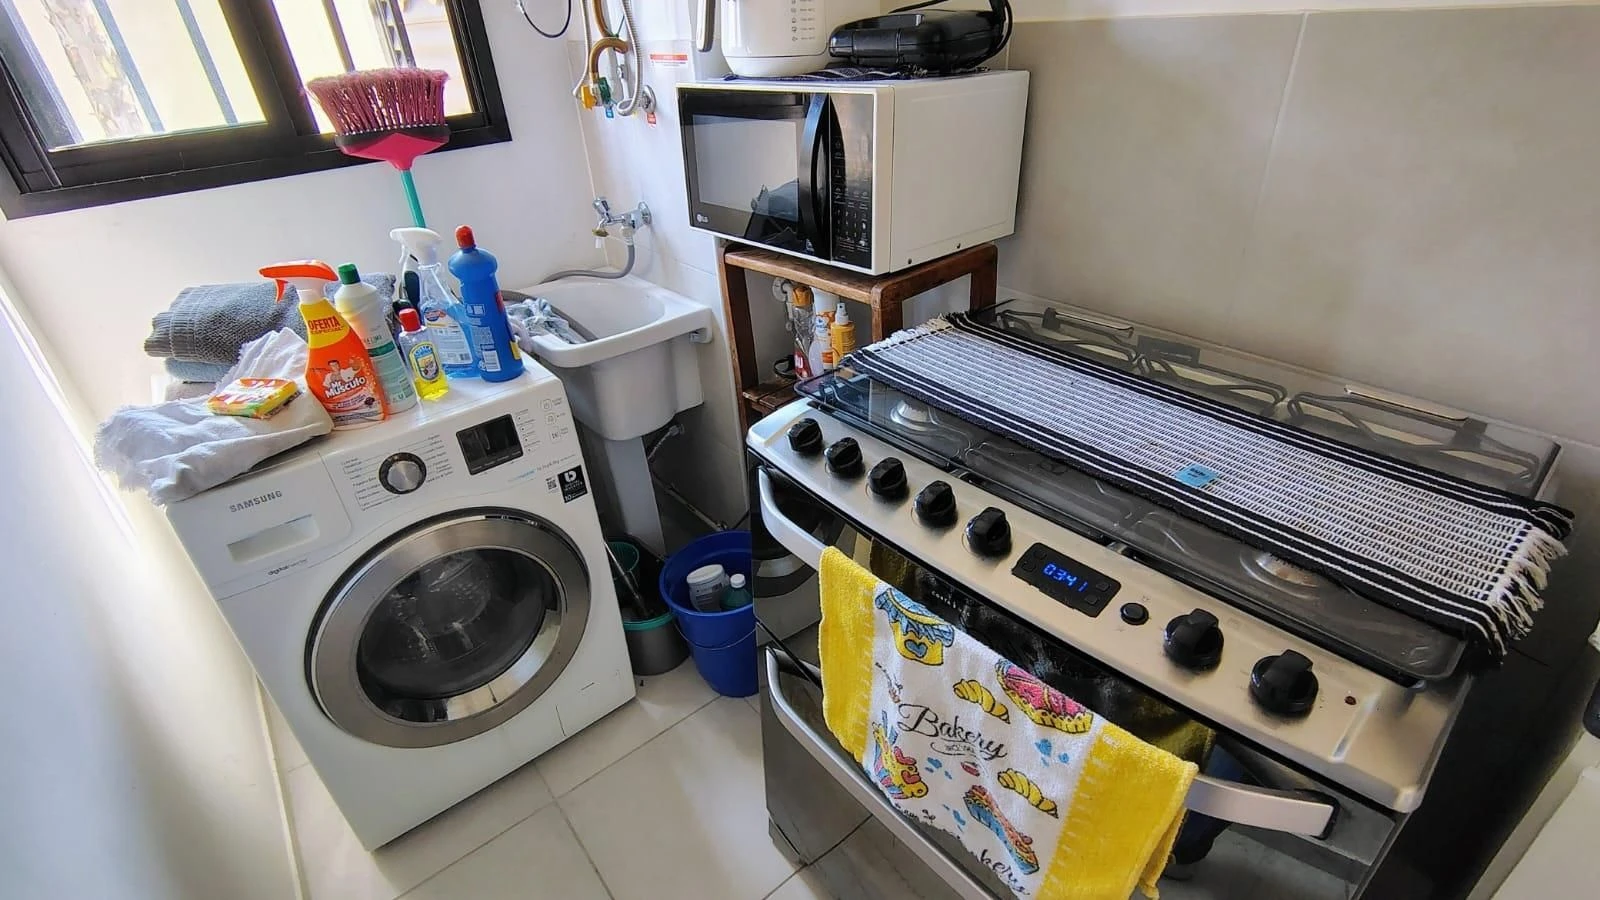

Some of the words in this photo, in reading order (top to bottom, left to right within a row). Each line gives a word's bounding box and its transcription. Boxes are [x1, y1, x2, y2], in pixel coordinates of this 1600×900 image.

[308, 315, 341, 331] OFERTA
[229, 490, 282, 513] SAMSUNG
[897, 703, 1008, 761] Bakery
